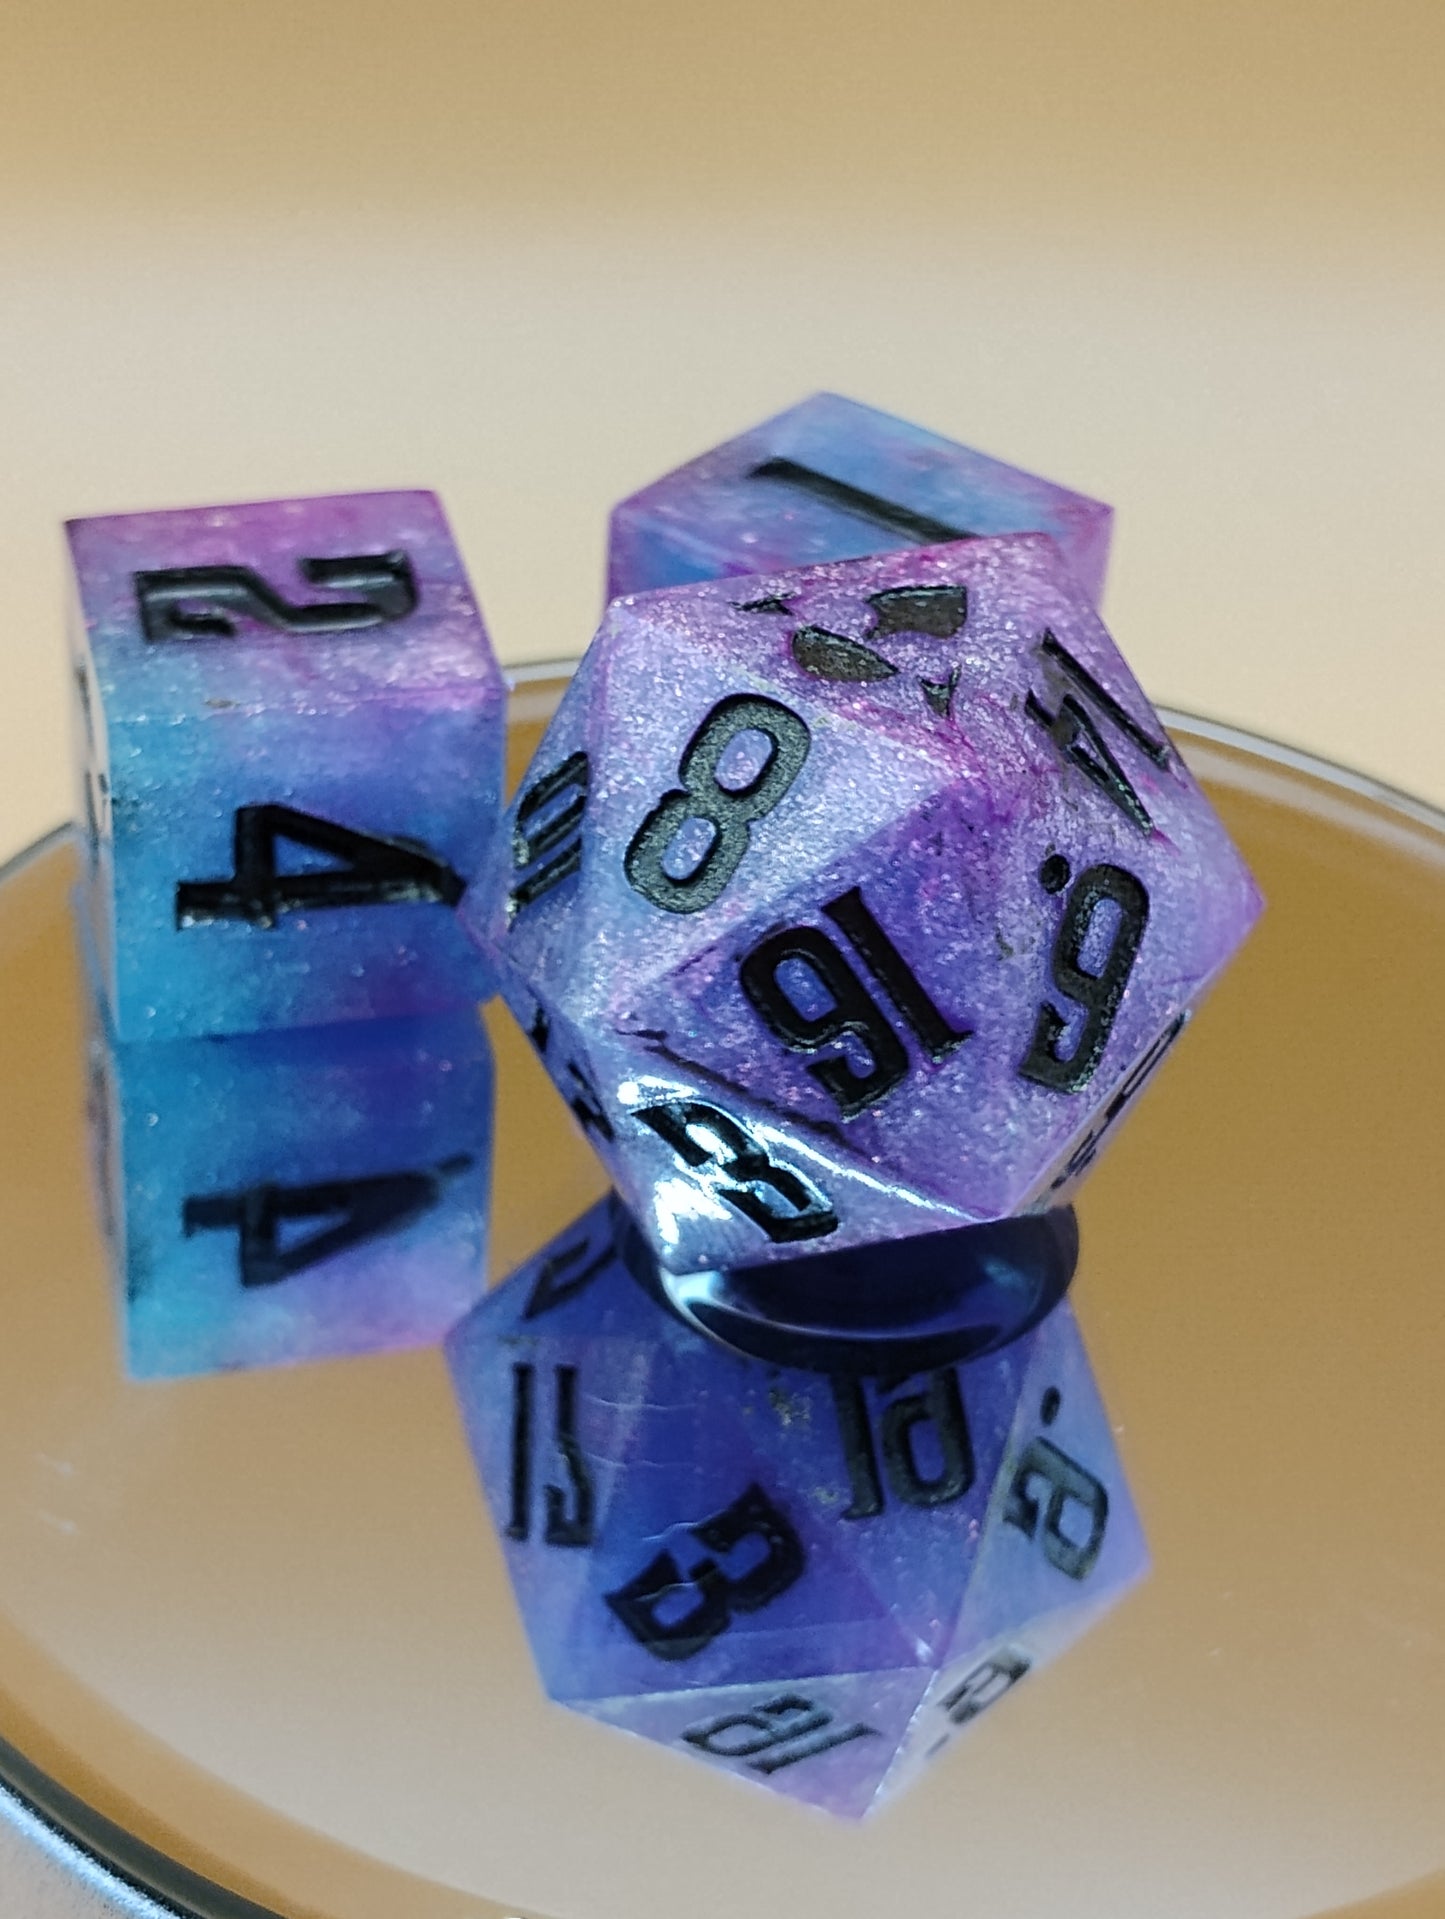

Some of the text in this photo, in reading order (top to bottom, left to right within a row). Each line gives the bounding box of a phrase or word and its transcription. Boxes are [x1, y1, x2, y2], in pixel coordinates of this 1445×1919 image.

[133, 548, 419, 643] 2
[175, 803, 467, 931] 4
[624, 693, 811, 915] 8
